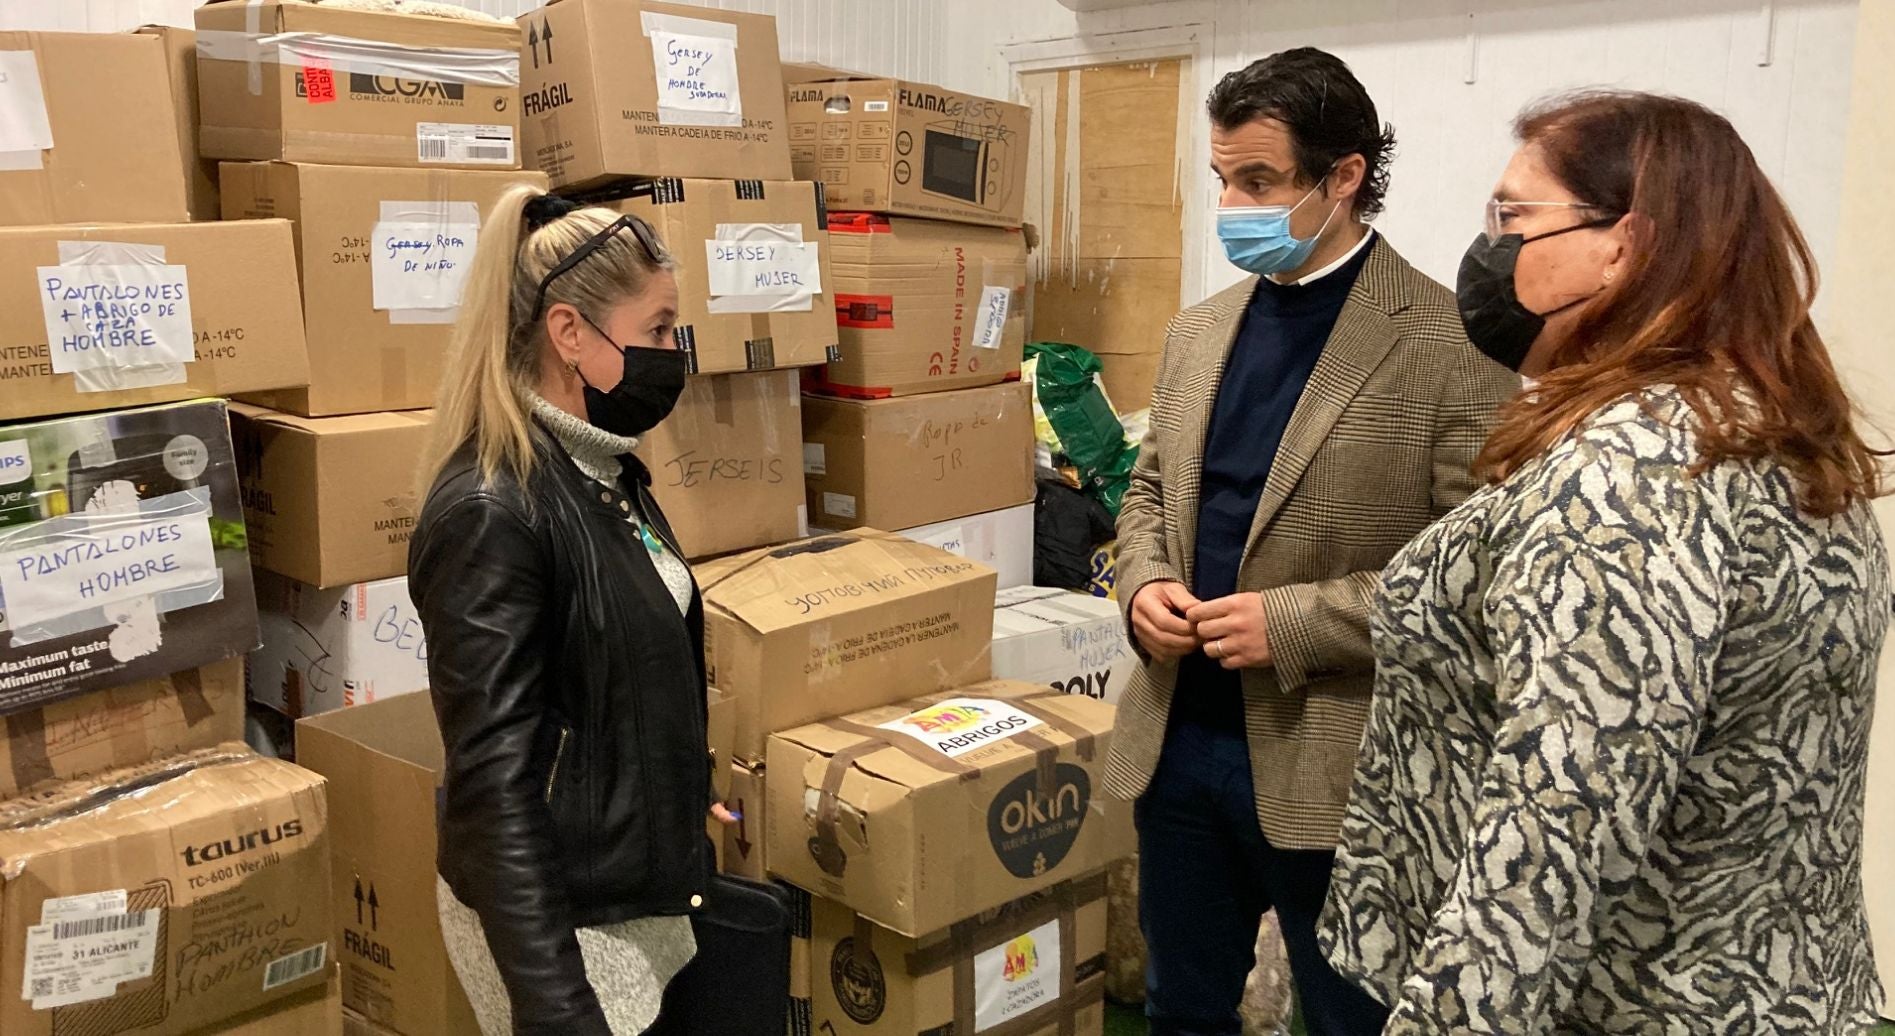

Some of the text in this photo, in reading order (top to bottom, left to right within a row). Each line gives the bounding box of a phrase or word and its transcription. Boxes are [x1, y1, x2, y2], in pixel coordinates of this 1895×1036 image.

[350, 93, 464, 107] COMERCIAL GRUPO ANAYA
[523, 82, 573, 117] FRÁGIL
[790, 89, 824, 103] FLAMA
[899, 88, 946, 114] FLAMA
[622, 109, 659, 123] MANTEN
[635, 124, 670, 137] MANTER
[671, 127, 678, 137] A
[711, 130, 722, 140] DE
[404, 259, 418, 272] DE
[46, 277, 184, 301] PANTALONES
[82, 301, 151, 321] ABRIGO
[159, 303, 175, 317] DE
[949, 247, 965, 375] MADE IN SPAIN
[62, 329, 156, 353] HOMBRE
[202, 331, 211, 344] A
[0, 362, 53, 379] MANTE
[665, 450, 783, 488] JERSEIS
[374, 516, 415, 531] MANTE
[388, 532, 410, 544] MAN
[17, 523, 182, 582] PANTALONES
[80, 554, 180, 599] HOMBRE
[867, 632, 877, 642] DE
[0, 641, 109, 674] Maximum taste
[858, 647, 869, 658] DE
[0, 666, 66, 690] Minimum
[69, 658, 91, 672] fat
[937, 715, 1027, 752] ABRIGOS
[179, 819, 303, 867] taurus
[187, 867, 234, 889] TC-600
[89, 940, 140, 957] ALICANTE
[344, 928, 396, 971] FRÁGIL
